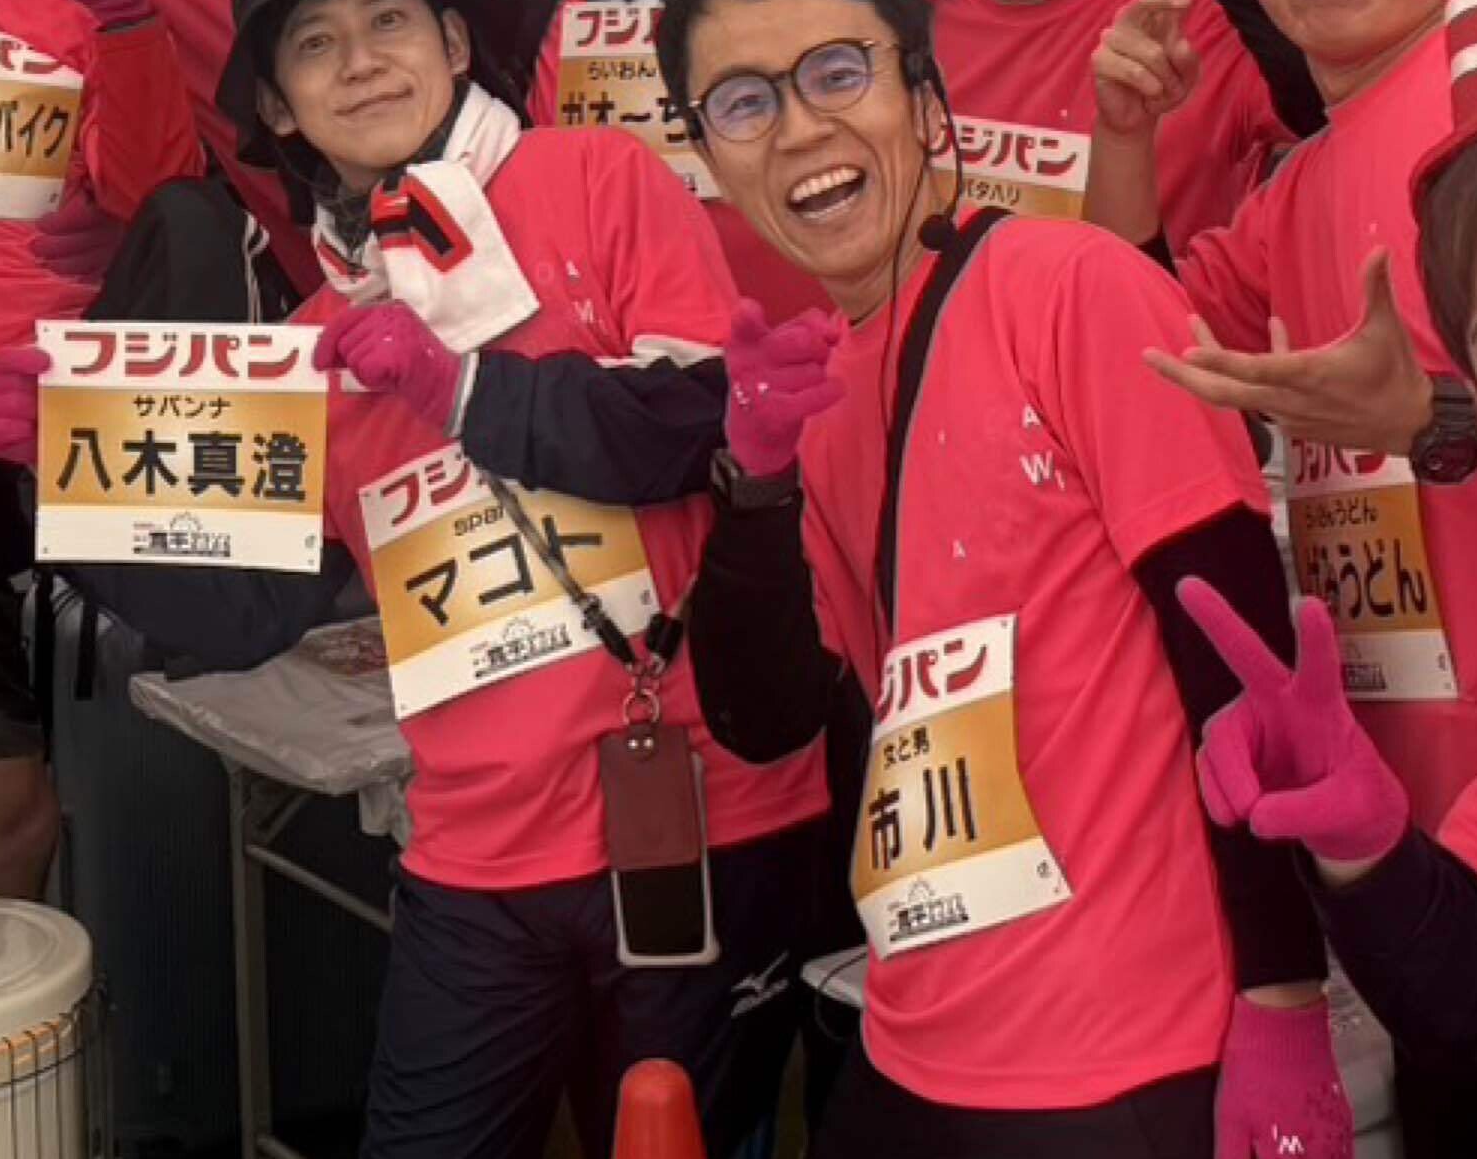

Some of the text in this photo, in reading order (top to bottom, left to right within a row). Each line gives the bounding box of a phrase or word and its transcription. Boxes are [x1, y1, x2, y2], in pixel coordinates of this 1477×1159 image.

[64, 331, 300, 380] フジパン
[133, 394, 232, 419] サバンナ
[56, 427, 308, 503] 八木真澄
[380, 453, 486, 527] フジ
[406, 514, 603, 625] マコト
[869, 757, 977, 870] 市川
